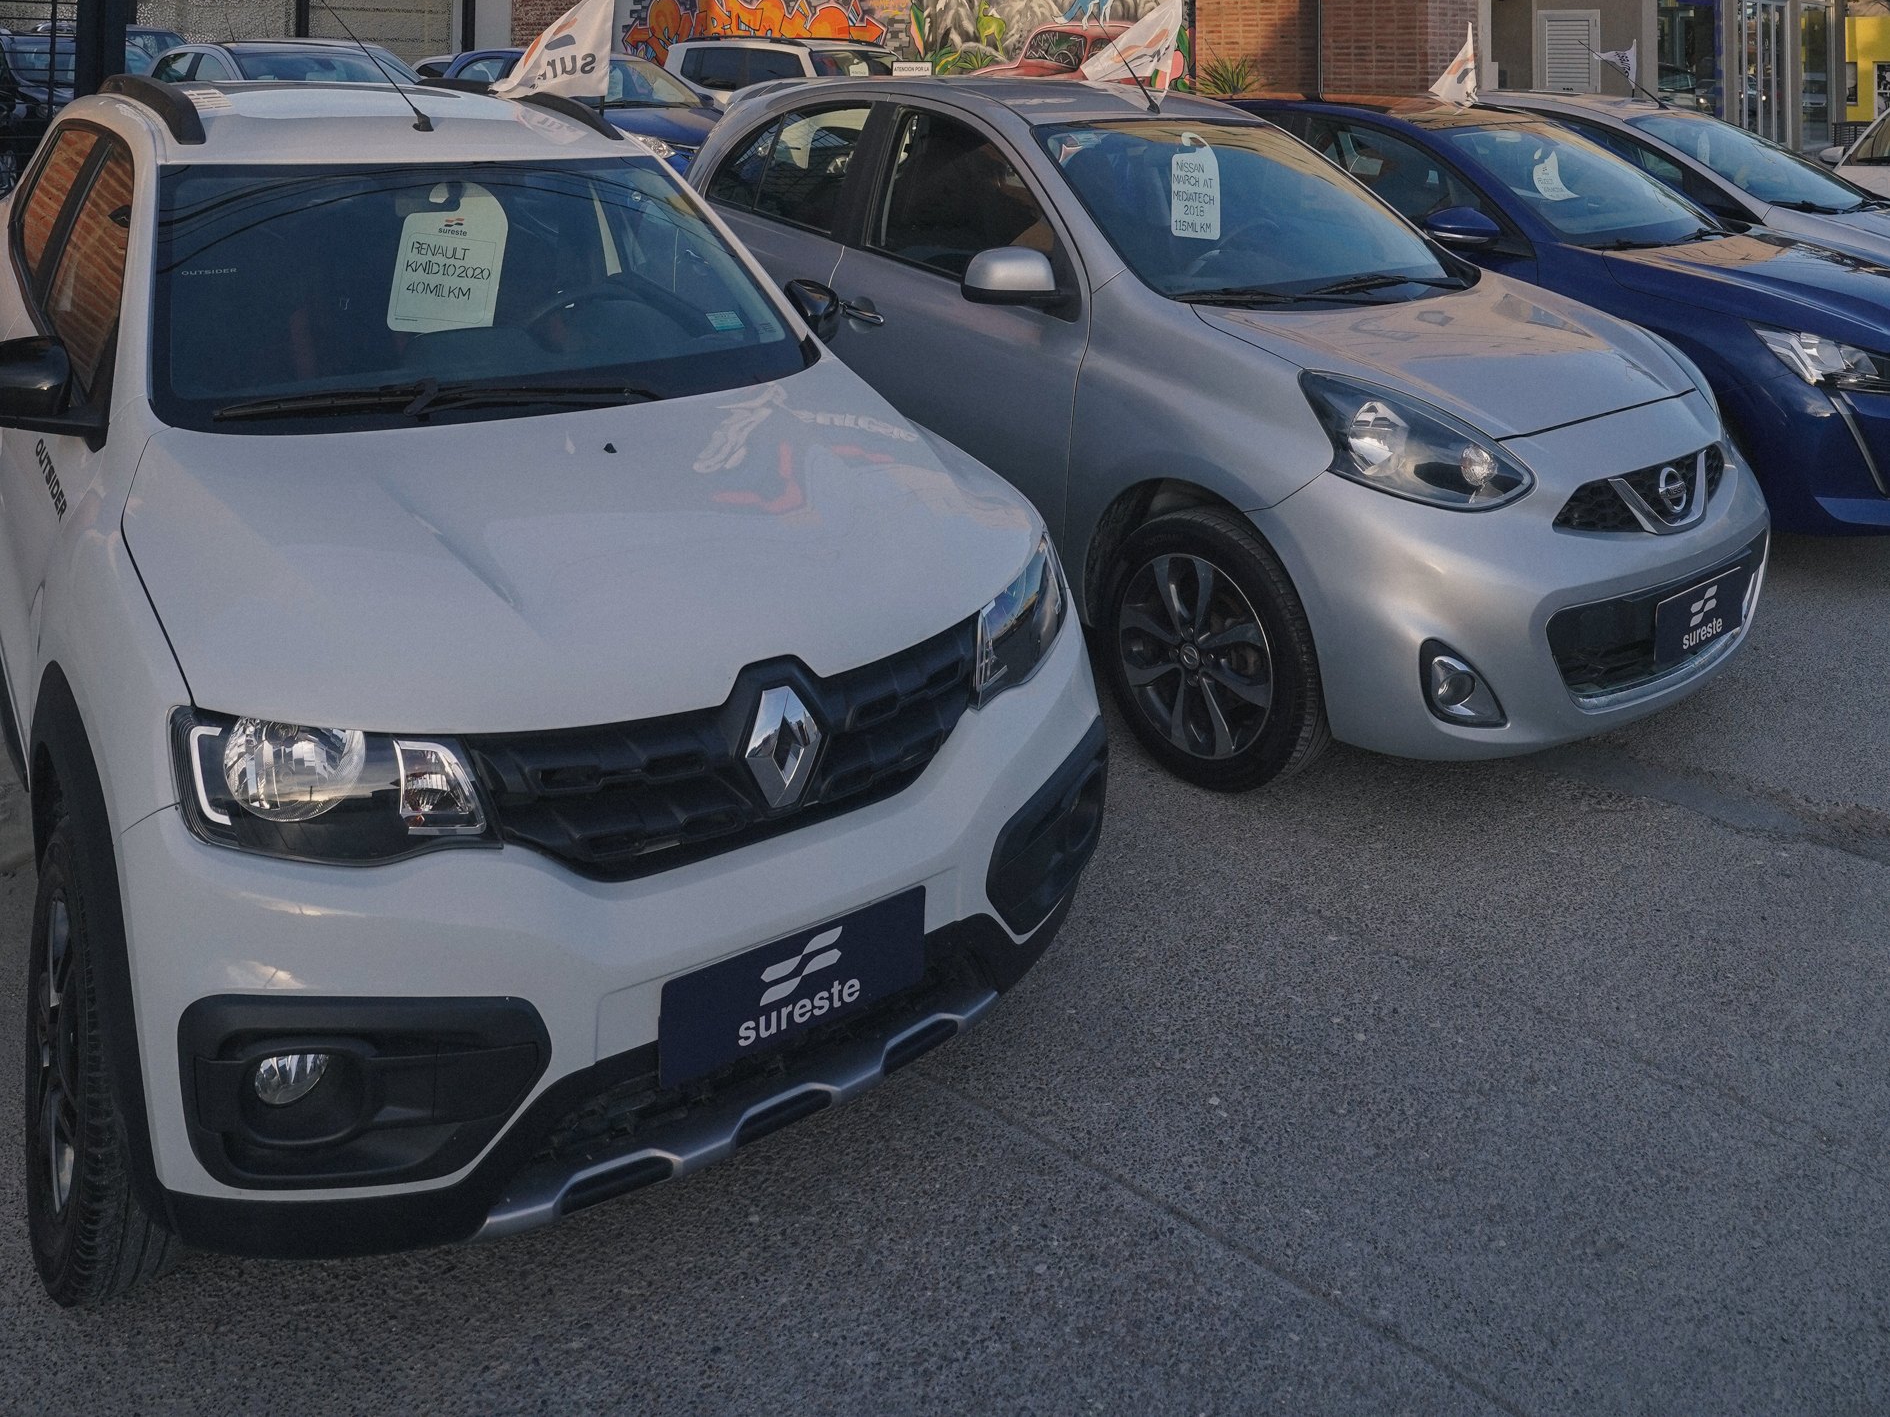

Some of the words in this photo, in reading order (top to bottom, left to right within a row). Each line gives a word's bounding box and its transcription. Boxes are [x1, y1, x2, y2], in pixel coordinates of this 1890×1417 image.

[1203, 178, 1214, 189] AT
[438, 227, 467, 237] sureste
[1200, 222, 1212, 233] KM
[410, 241, 471, 261] RENAULT
[181, 267, 237, 276] OUTSIDER
[457, 265, 491, 280] 2020
[36, 438, 67, 523] OUTSIDER
[1682, 617, 1723, 650] sureste
[737, 978, 861, 1047] sureste
